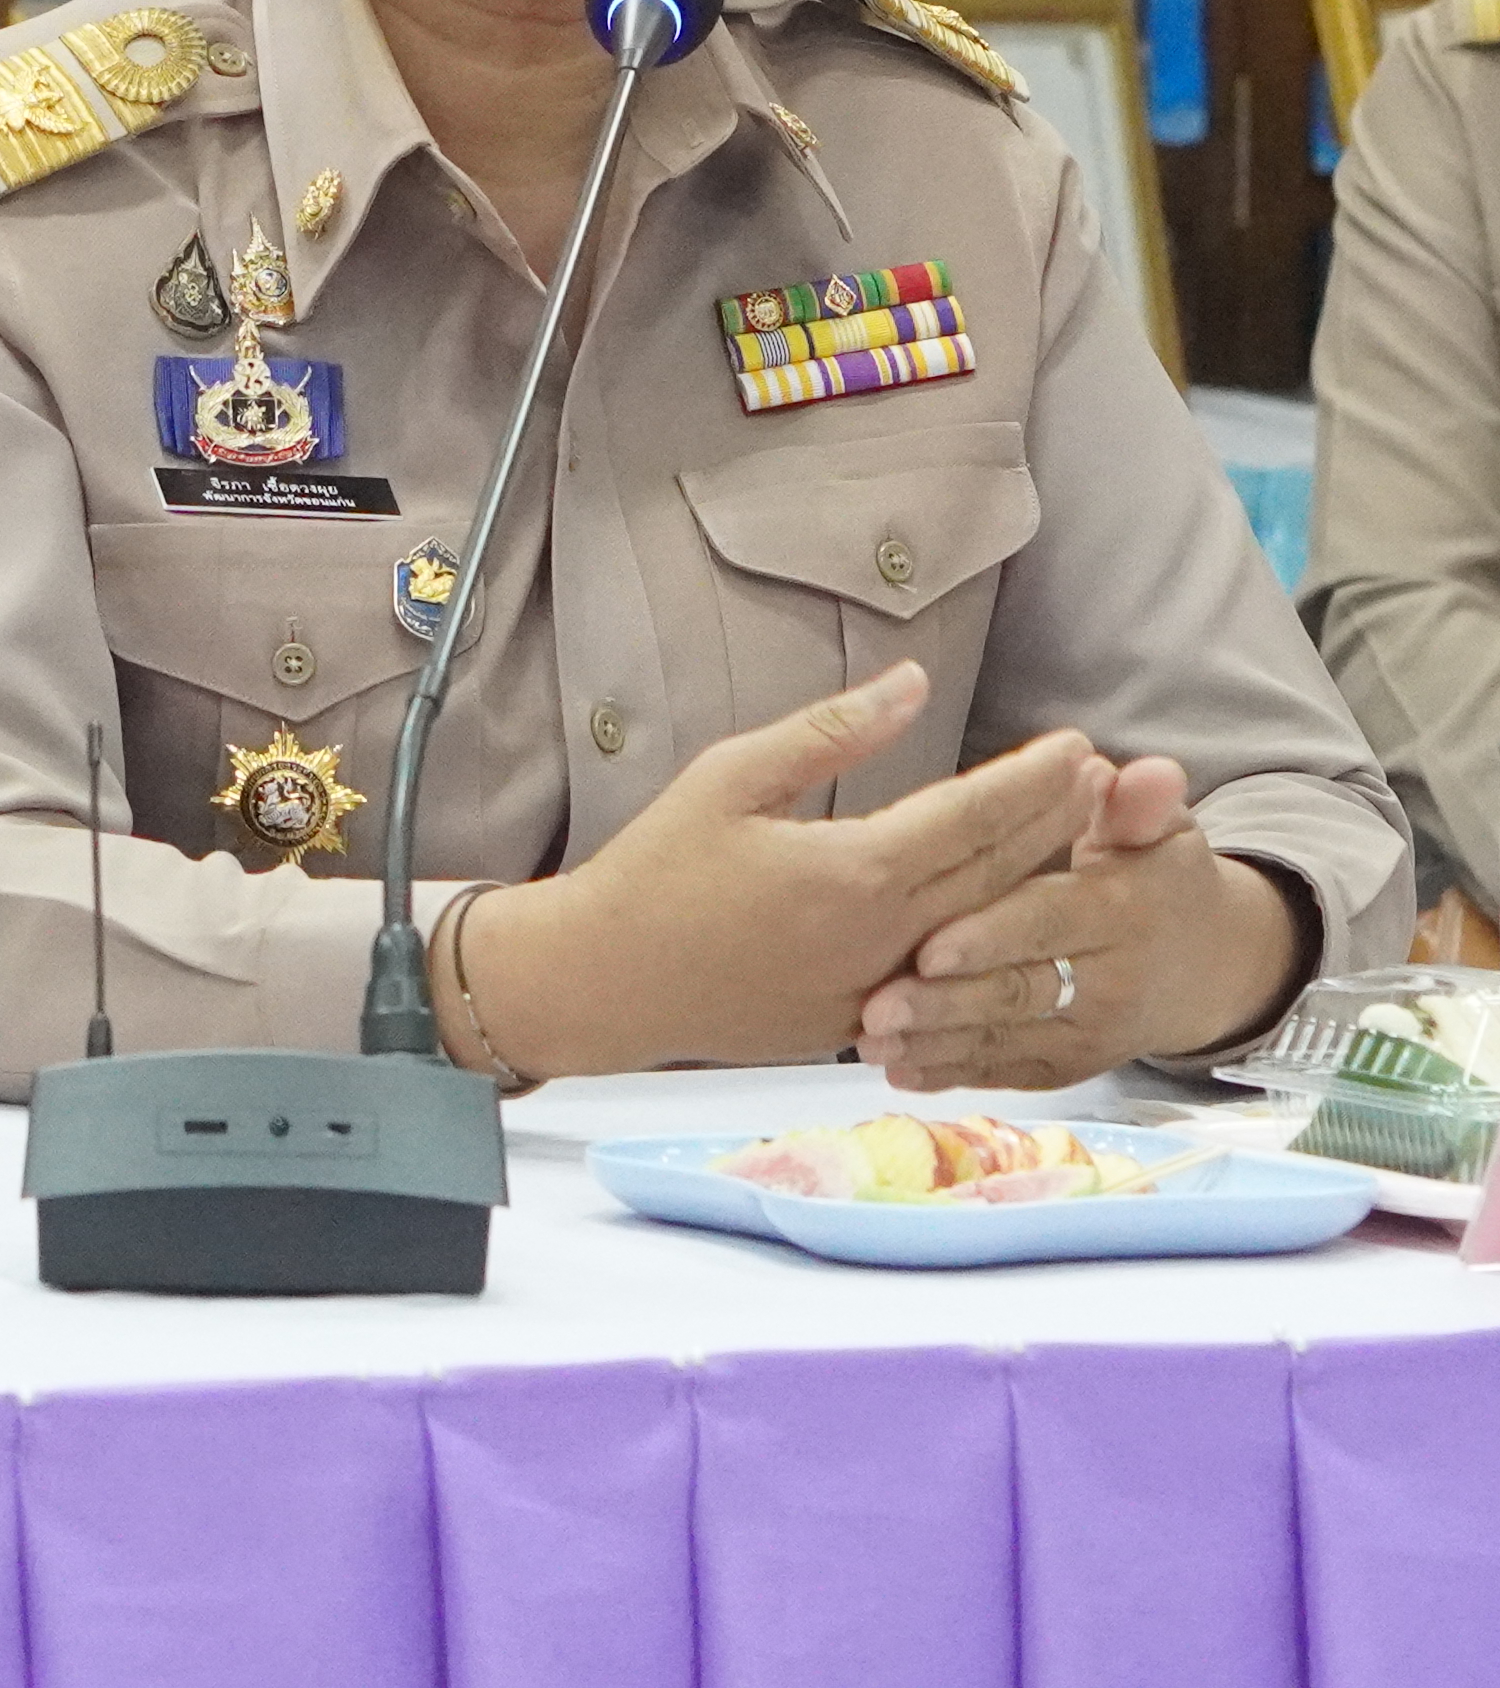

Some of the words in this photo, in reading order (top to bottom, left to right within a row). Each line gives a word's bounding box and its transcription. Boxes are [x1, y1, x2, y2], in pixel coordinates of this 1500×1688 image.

[209, 476, 251, 491] จิรภา
[262, 475, 339, 497] เชื้อดวงผุย
[201, 490, 357, 508] พัฒนาการจังหวัดขอนแก่น
